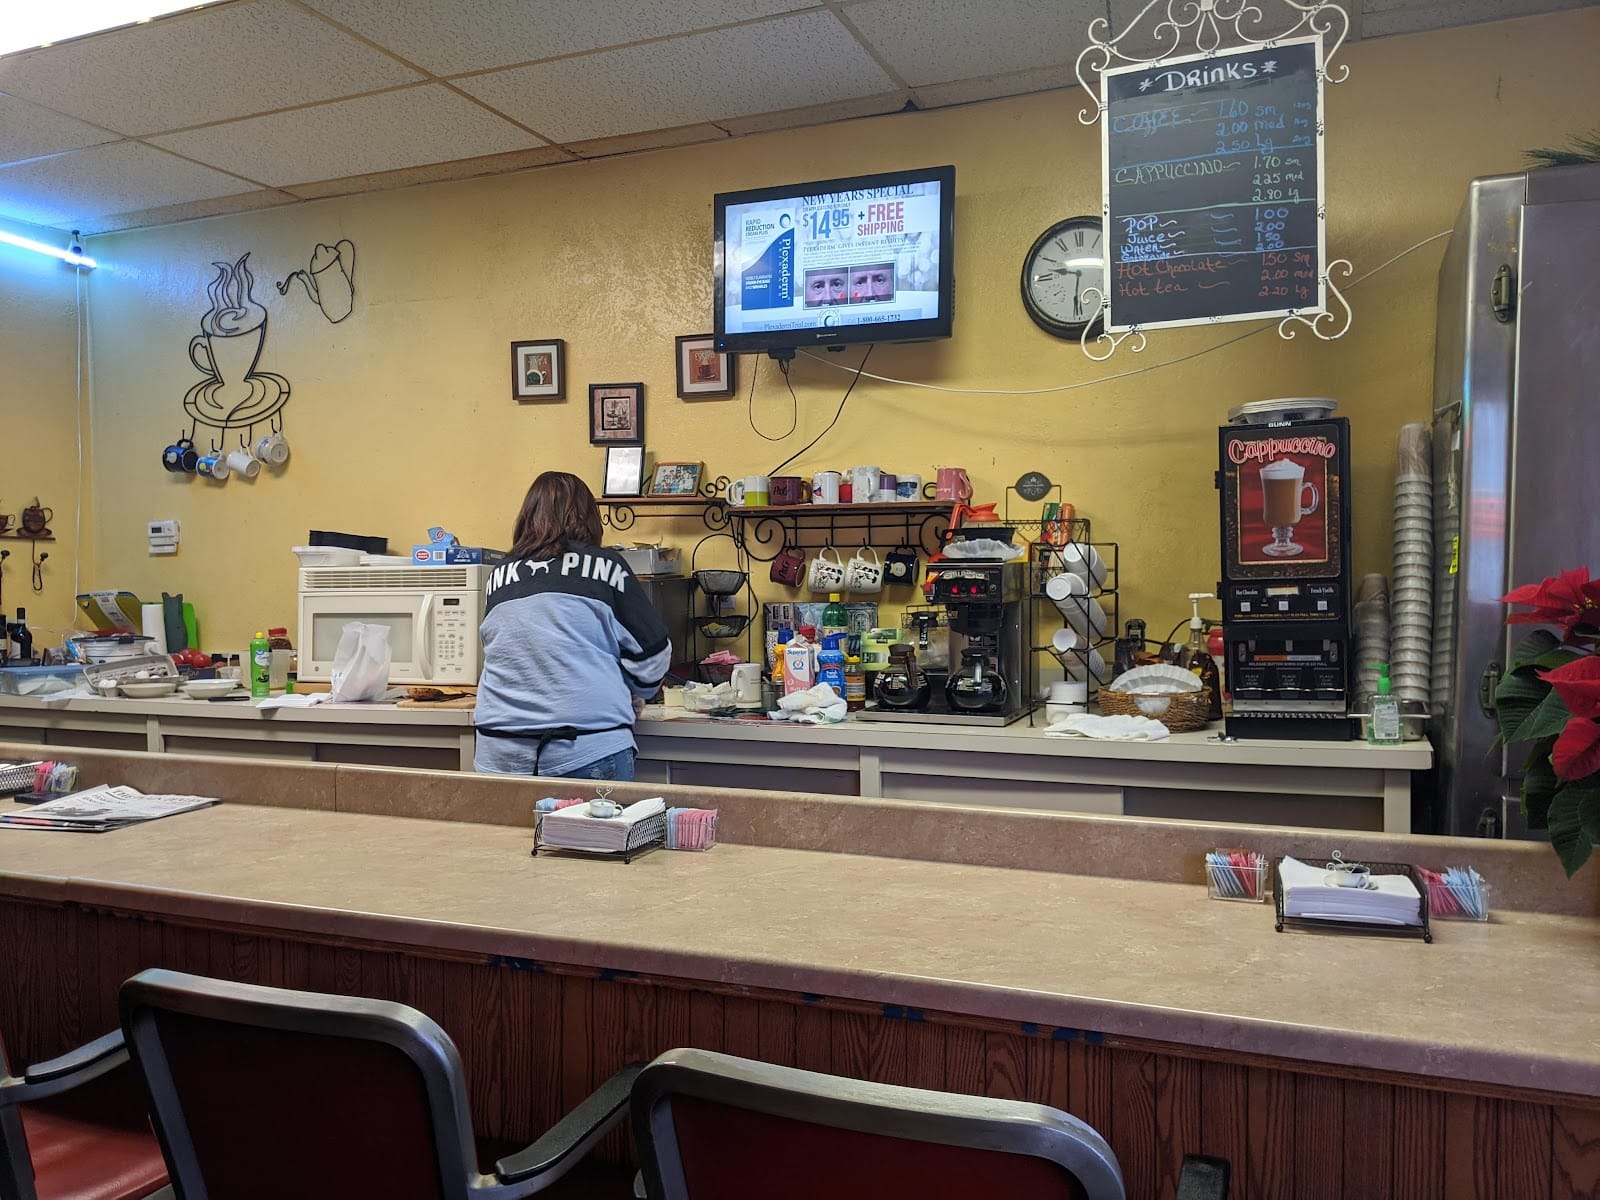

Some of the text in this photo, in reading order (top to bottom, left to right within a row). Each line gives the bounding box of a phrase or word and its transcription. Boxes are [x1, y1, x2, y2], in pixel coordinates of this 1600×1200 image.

[868, 202, 905, 222] FREE
[857, 221, 905, 237] SHIPPING
[782, 238, 793, 299] Plexaderm
[1229, 437, 1336, 464] Cappuccino
[561, 552, 630, 593] PINK
